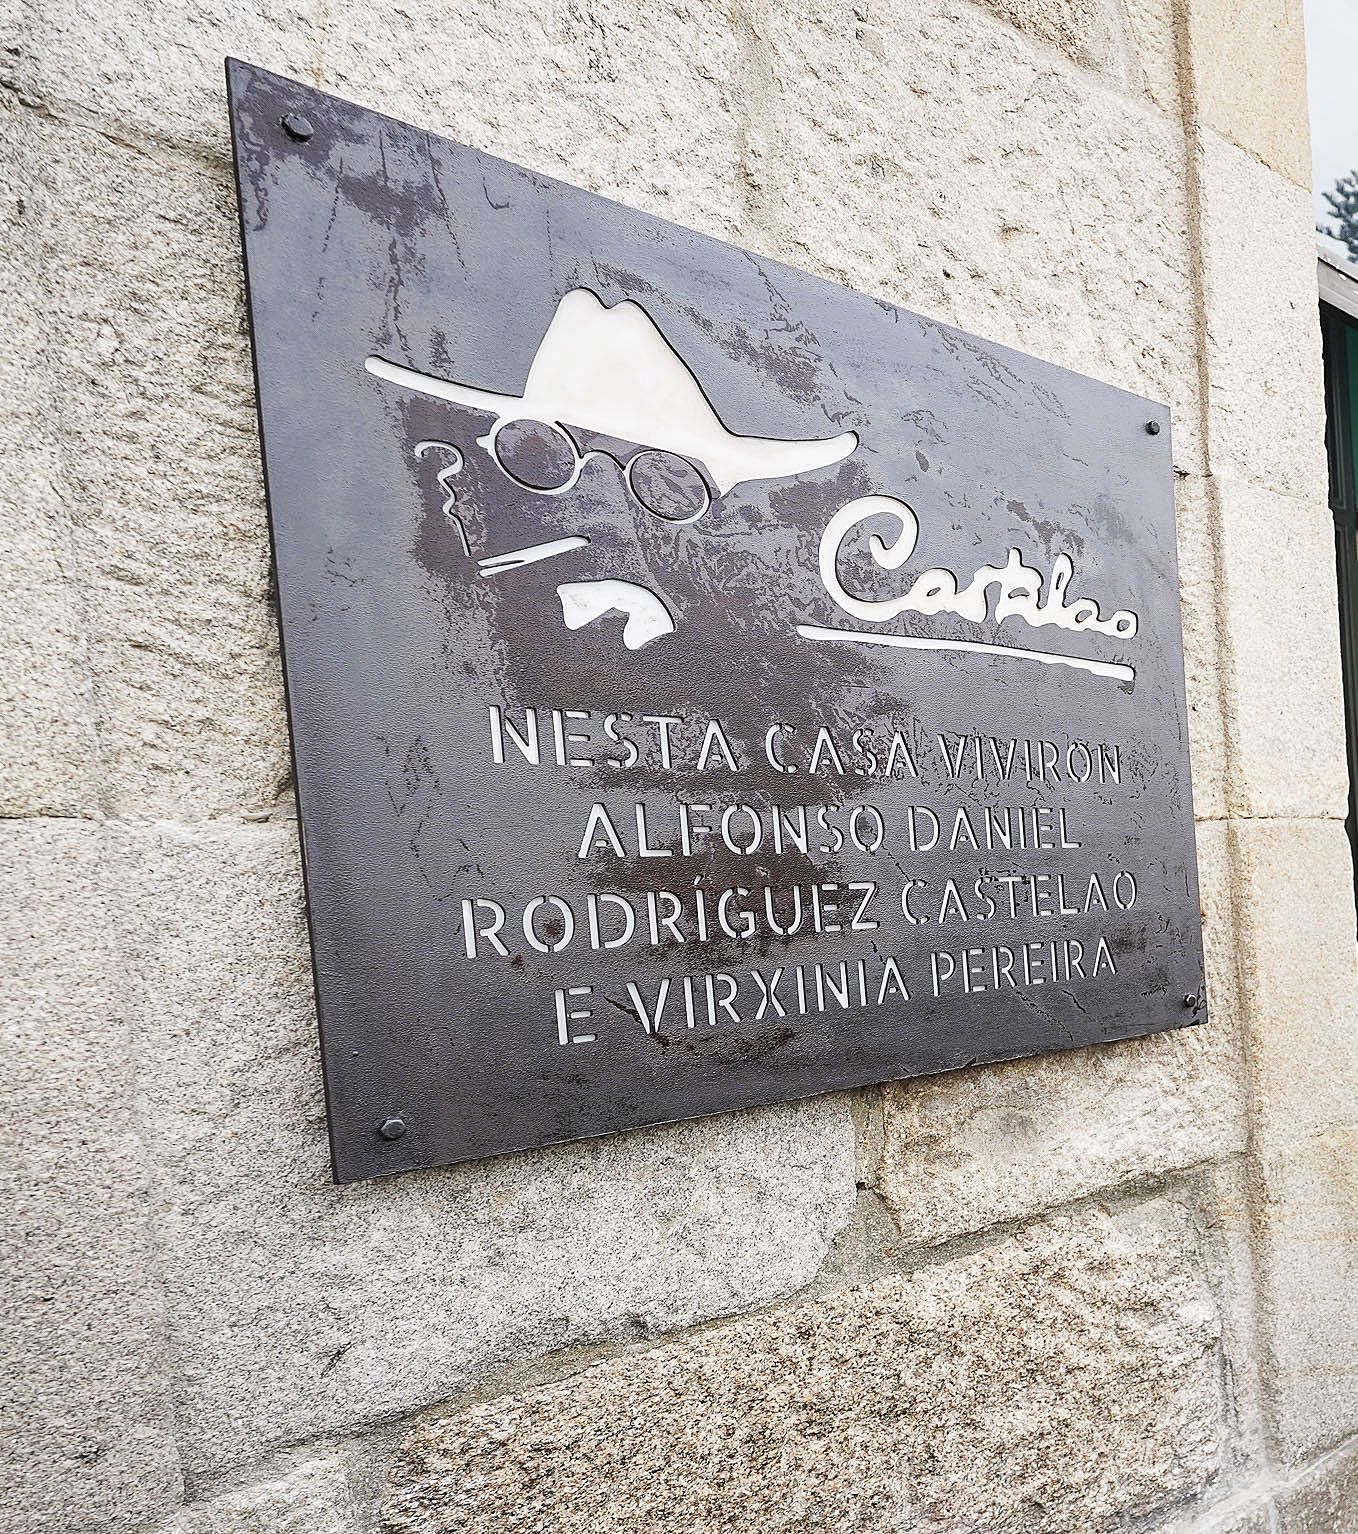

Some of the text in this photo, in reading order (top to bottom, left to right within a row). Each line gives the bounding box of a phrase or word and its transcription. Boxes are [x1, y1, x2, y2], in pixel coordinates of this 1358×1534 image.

[488, 704, 740, 771] NESTA
[766, 722, 918, 778] CASA
[578, 802, 1081, 859] ALFONSO DANIEL
[461, 871, 1138, 959] RODRÍGUEZ CASTELAO
[554, 935, 1117, 1046] E VIRXINIA PEREIRA
